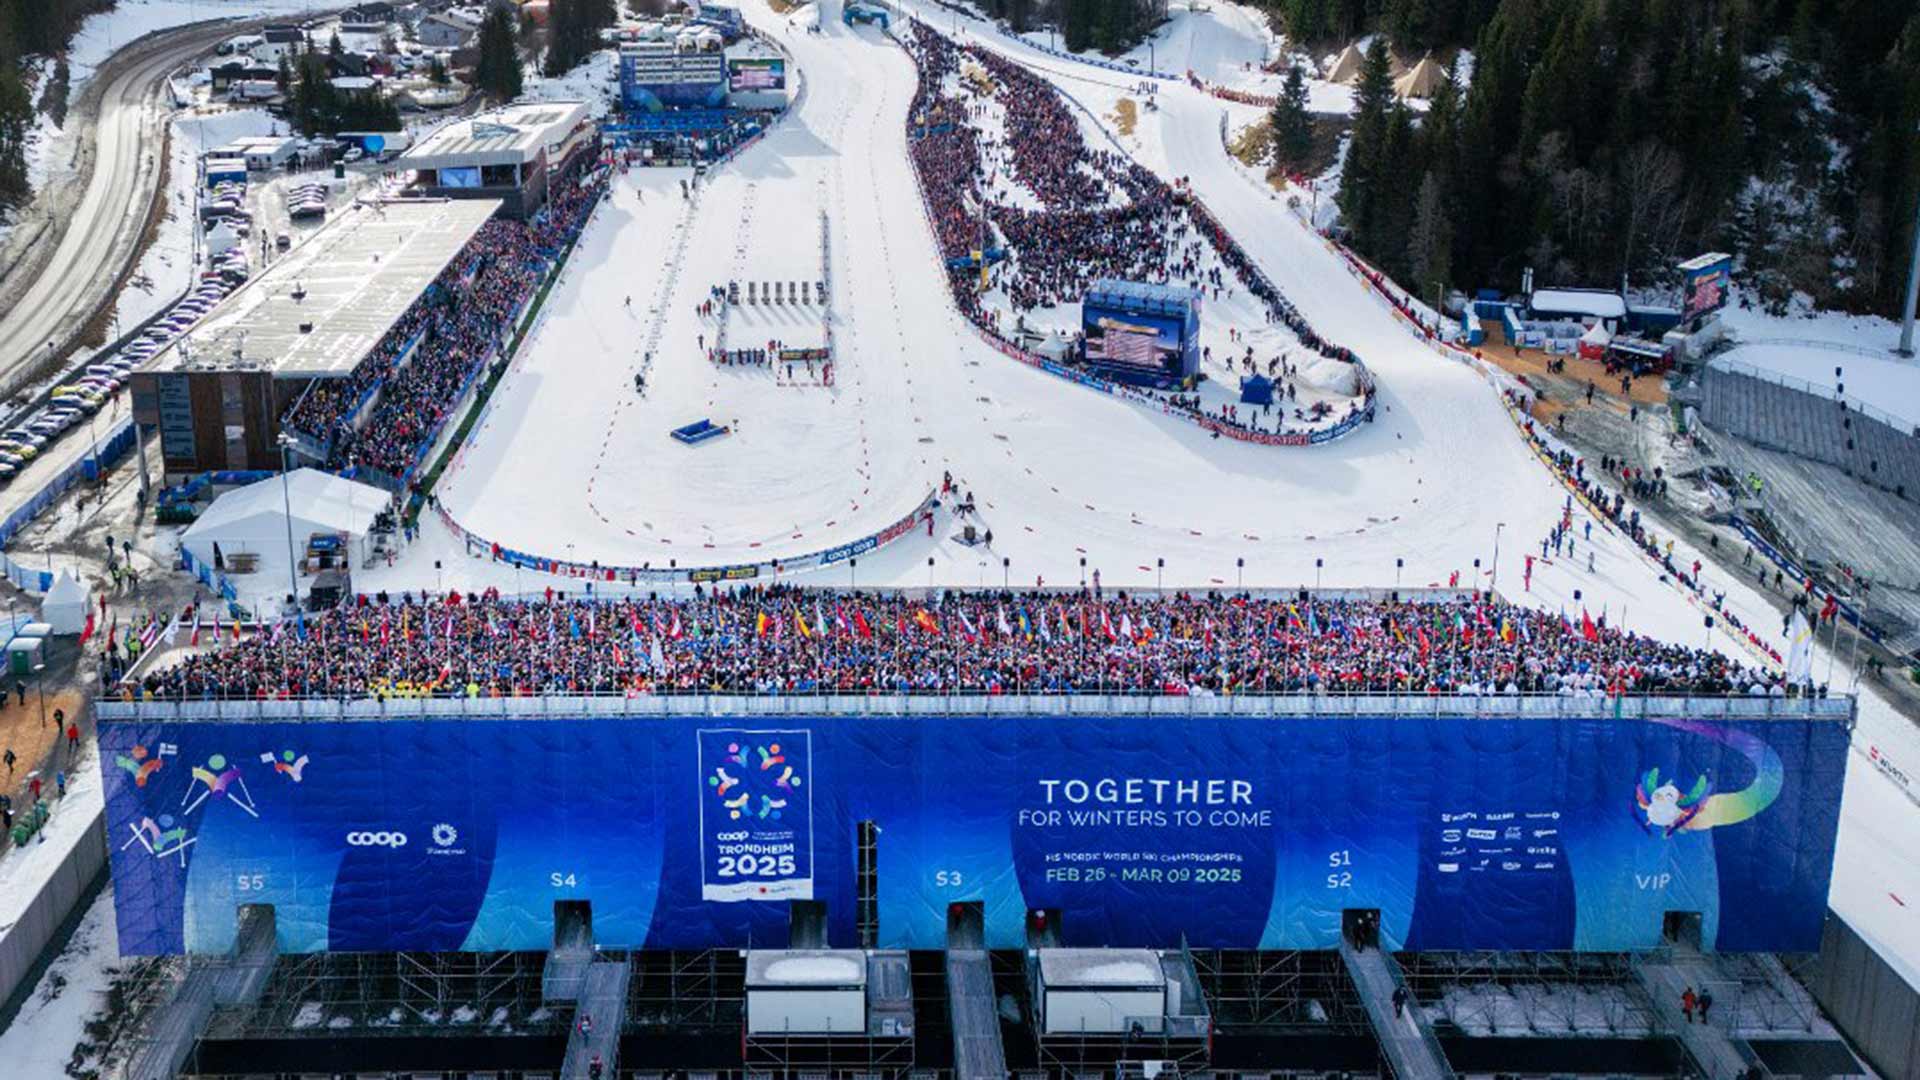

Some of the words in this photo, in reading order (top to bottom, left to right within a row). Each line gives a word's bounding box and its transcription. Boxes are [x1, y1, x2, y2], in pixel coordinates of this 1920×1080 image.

[1039, 778, 1253, 805] TOGETHER
[1018, 809, 1061, 827] FOR
[1067, 809, 1168, 827] WINTERS
[1174, 810, 1202, 827] TO
[1208, 810, 1272, 827] COME
[346, 831, 408, 849] coop
[717, 830, 749, 841] coop
[717, 843, 794, 855] TRONDHEIM
[1063, 852, 1100, 861] NORDIC
[1103, 851, 1140, 861] WORLD
[1160, 853, 1244, 862] CHAMPIONSHIPS
[717, 854, 796, 877] 2025
[1329, 849, 1352, 868] S1
[238, 874, 264, 890] S5
[551, 872, 577, 888] S4
[935, 869, 963, 887] S3
[1046, 868, 1080, 883] FEB
[1084, 867, 1106, 882] 26
[1122, 868, 1163, 883] MAR
[1167, 867, 1190, 883] 09
[1195, 868, 1242, 882] 2025
[1327, 871, 1352, 889] S2
[1635, 872, 1671, 890] VIP
